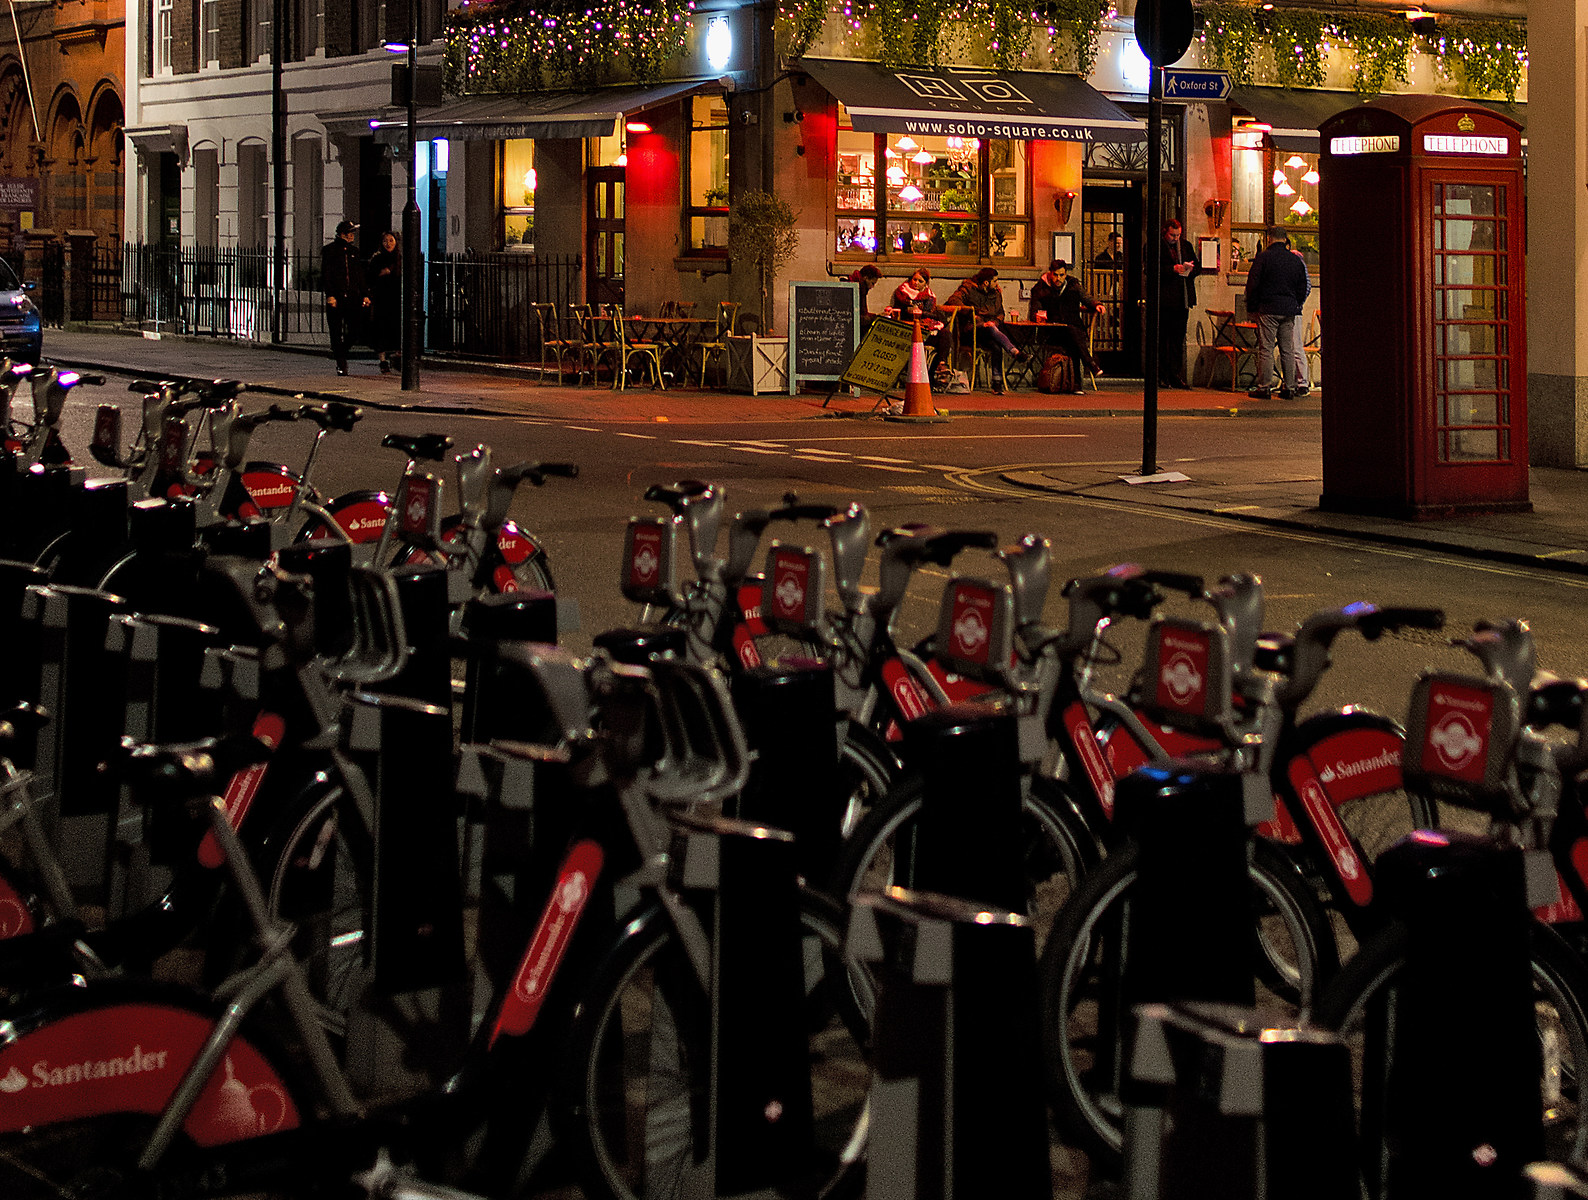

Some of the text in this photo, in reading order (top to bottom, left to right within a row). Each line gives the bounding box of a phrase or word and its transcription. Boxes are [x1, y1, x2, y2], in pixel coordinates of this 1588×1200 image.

[1180, 80, 1218, 90] Oxford St
[928, 101, 1047, 113] SQUARE
[905, 120, 1094, 141] www.soho-square.co.uk
[1333, 136, 1399, 152] TELEPHONE
[1429, 137, 1505, 153] TELEPHONE
[872, 349, 897, 362] CLOSED
[1334, 748, 1401, 780] Santander
[31, 1044, 168, 1089] Santander
